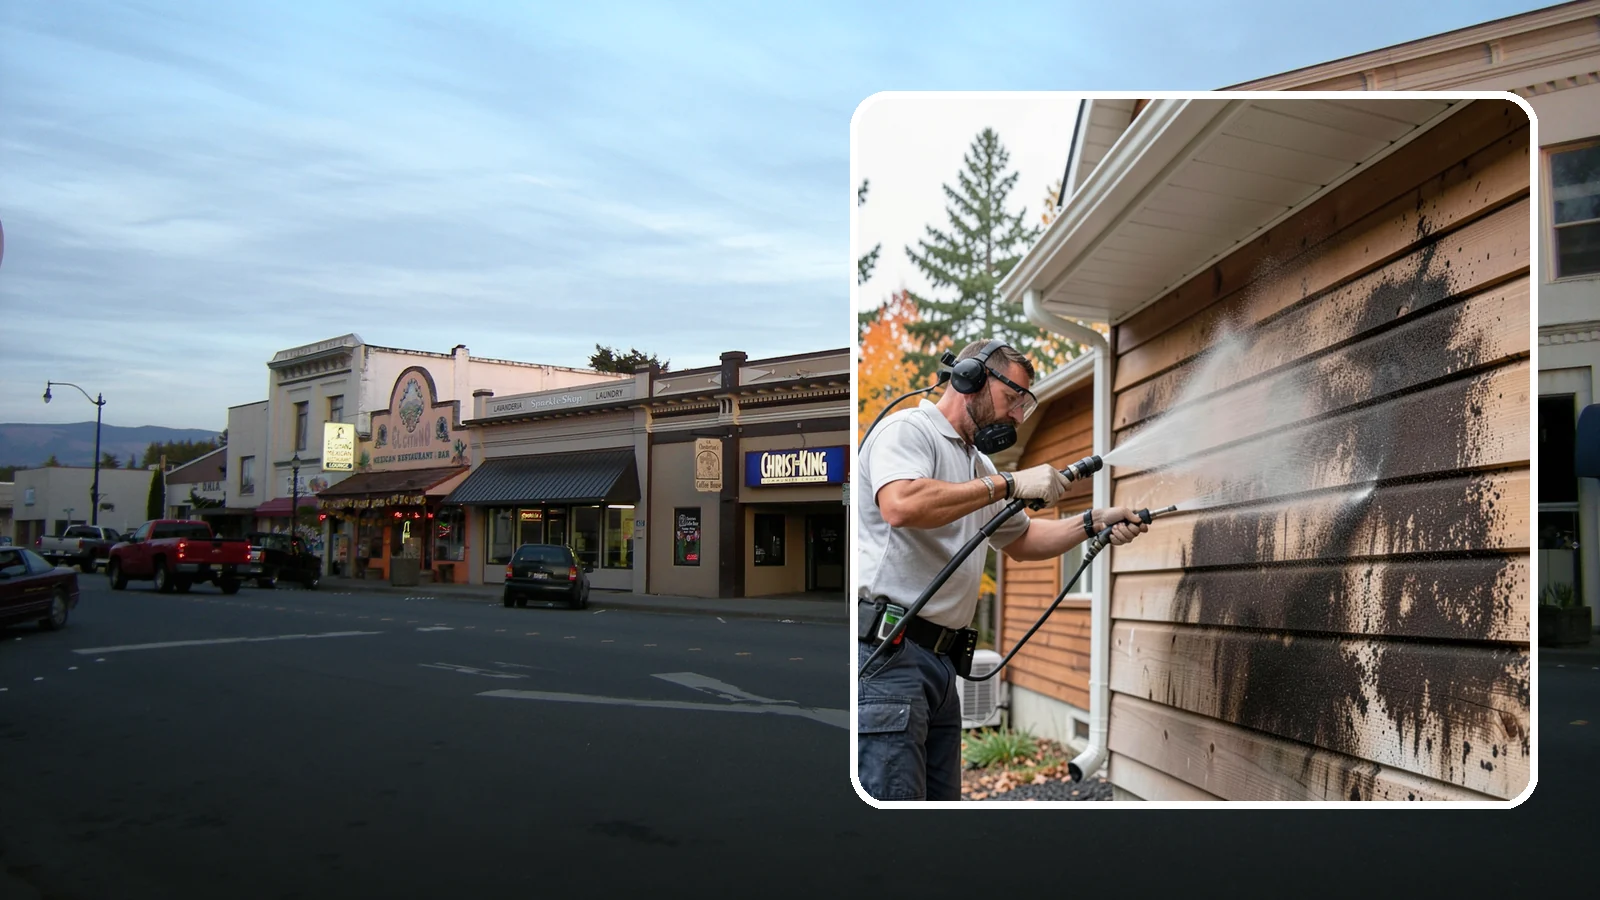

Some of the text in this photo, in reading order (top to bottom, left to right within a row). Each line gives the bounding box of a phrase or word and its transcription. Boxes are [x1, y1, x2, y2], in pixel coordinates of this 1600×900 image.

[595, 389, 623, 400] LAUNDRY
[493, 401, 522, 412] LAVANDERIA
[530, 394, 582, 408] Sparkle Shop
[397, 451, 433, 462] RESTAURANT
[437, 450, 450, 459] BAR
[761, 450, 827, 478] CHRIST KING
